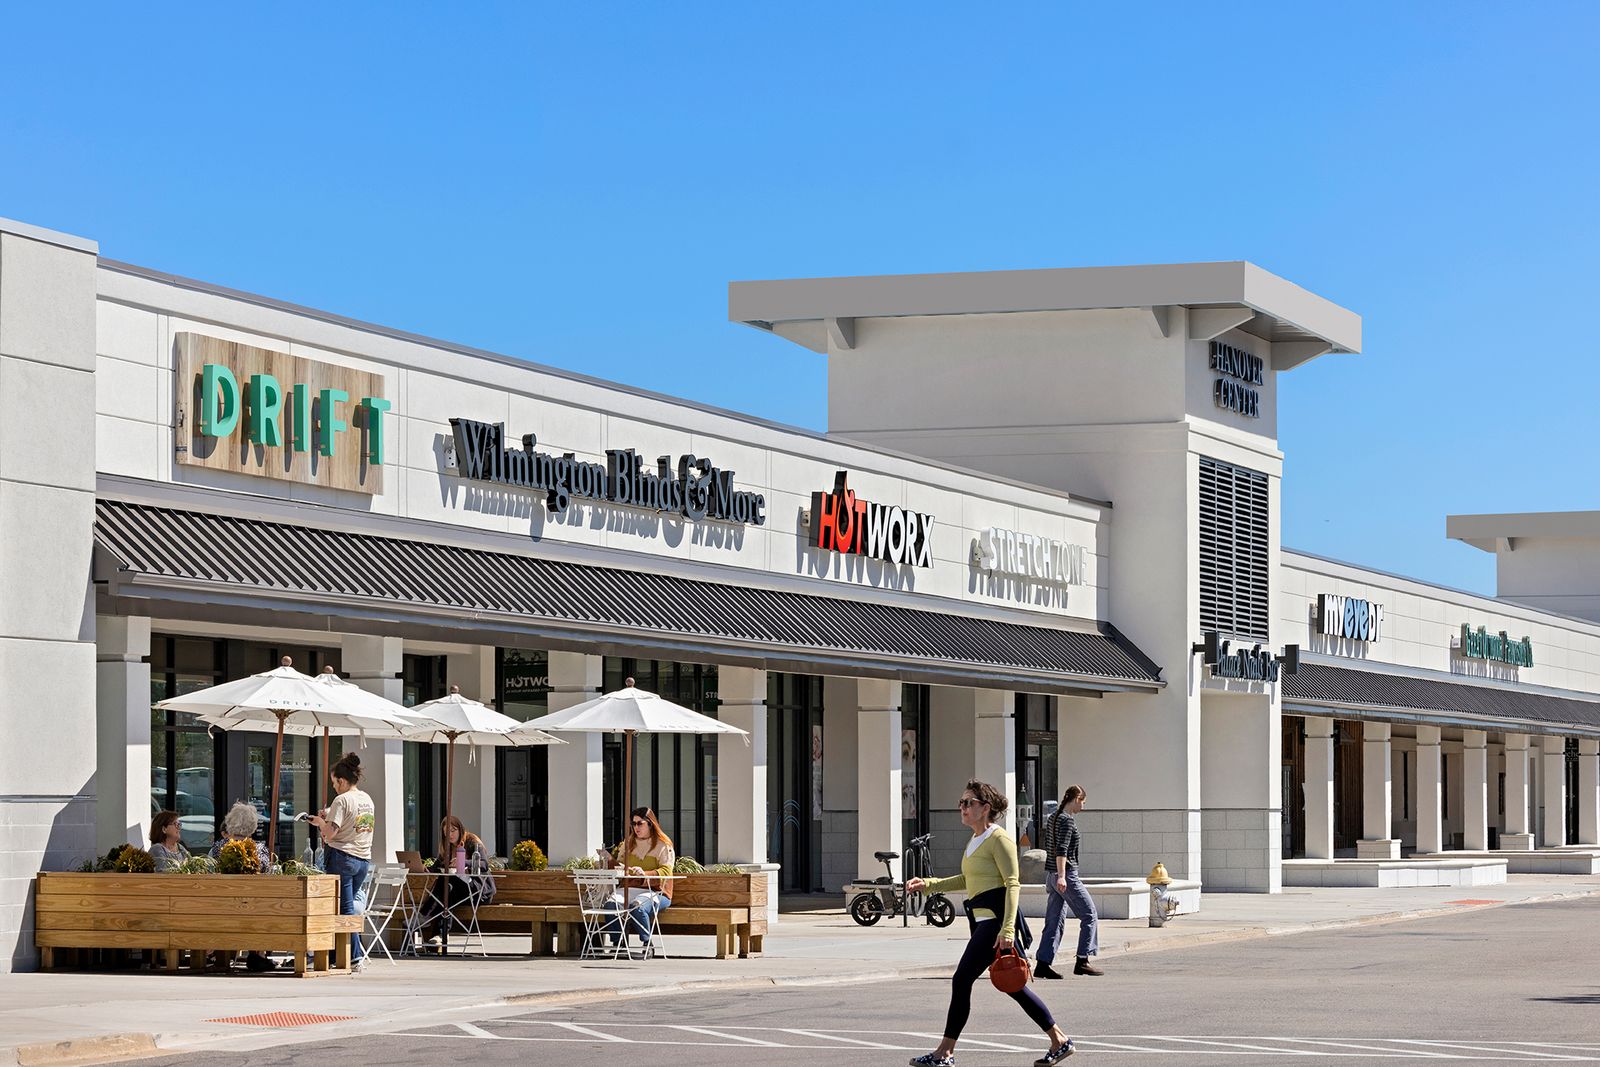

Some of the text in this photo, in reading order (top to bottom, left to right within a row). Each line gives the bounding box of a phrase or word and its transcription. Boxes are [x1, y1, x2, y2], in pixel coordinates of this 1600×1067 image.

[1208, 340, 1264, 386] HANOVER
[201, 363, 391, 466] DRIFT
[1213, 379, 1260, 418] CENTER
[448, 418, 766, 526] Wilmington Blinds & More
[809, 470, 936, 569] HOTWORX
[980, 526, 1088, 587] STRETCH ZONE
[269, 699, 323, 708] DRIFT
